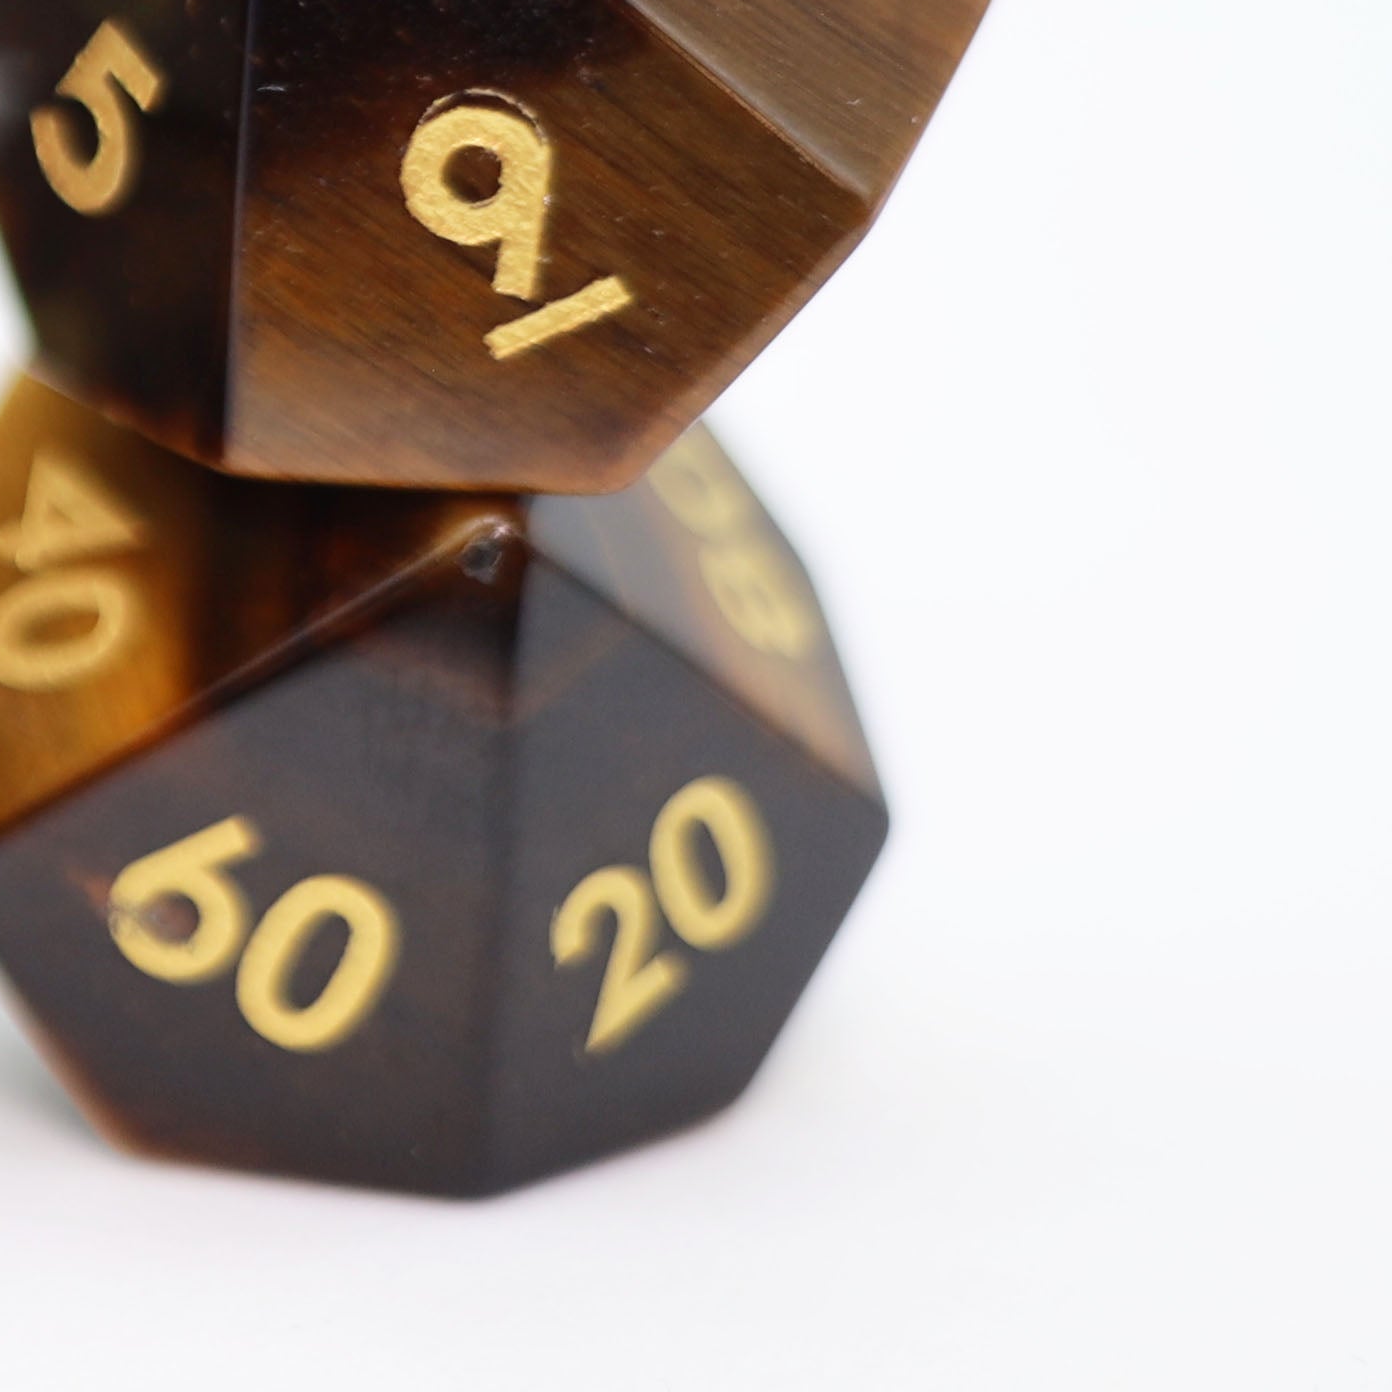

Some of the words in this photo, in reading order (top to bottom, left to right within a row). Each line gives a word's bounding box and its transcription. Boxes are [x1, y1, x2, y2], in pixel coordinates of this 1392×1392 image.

[29, 19, 165, 216] 5
[108, 815, 401, 1054] 60
[550, 775, 775, 1056] 20
